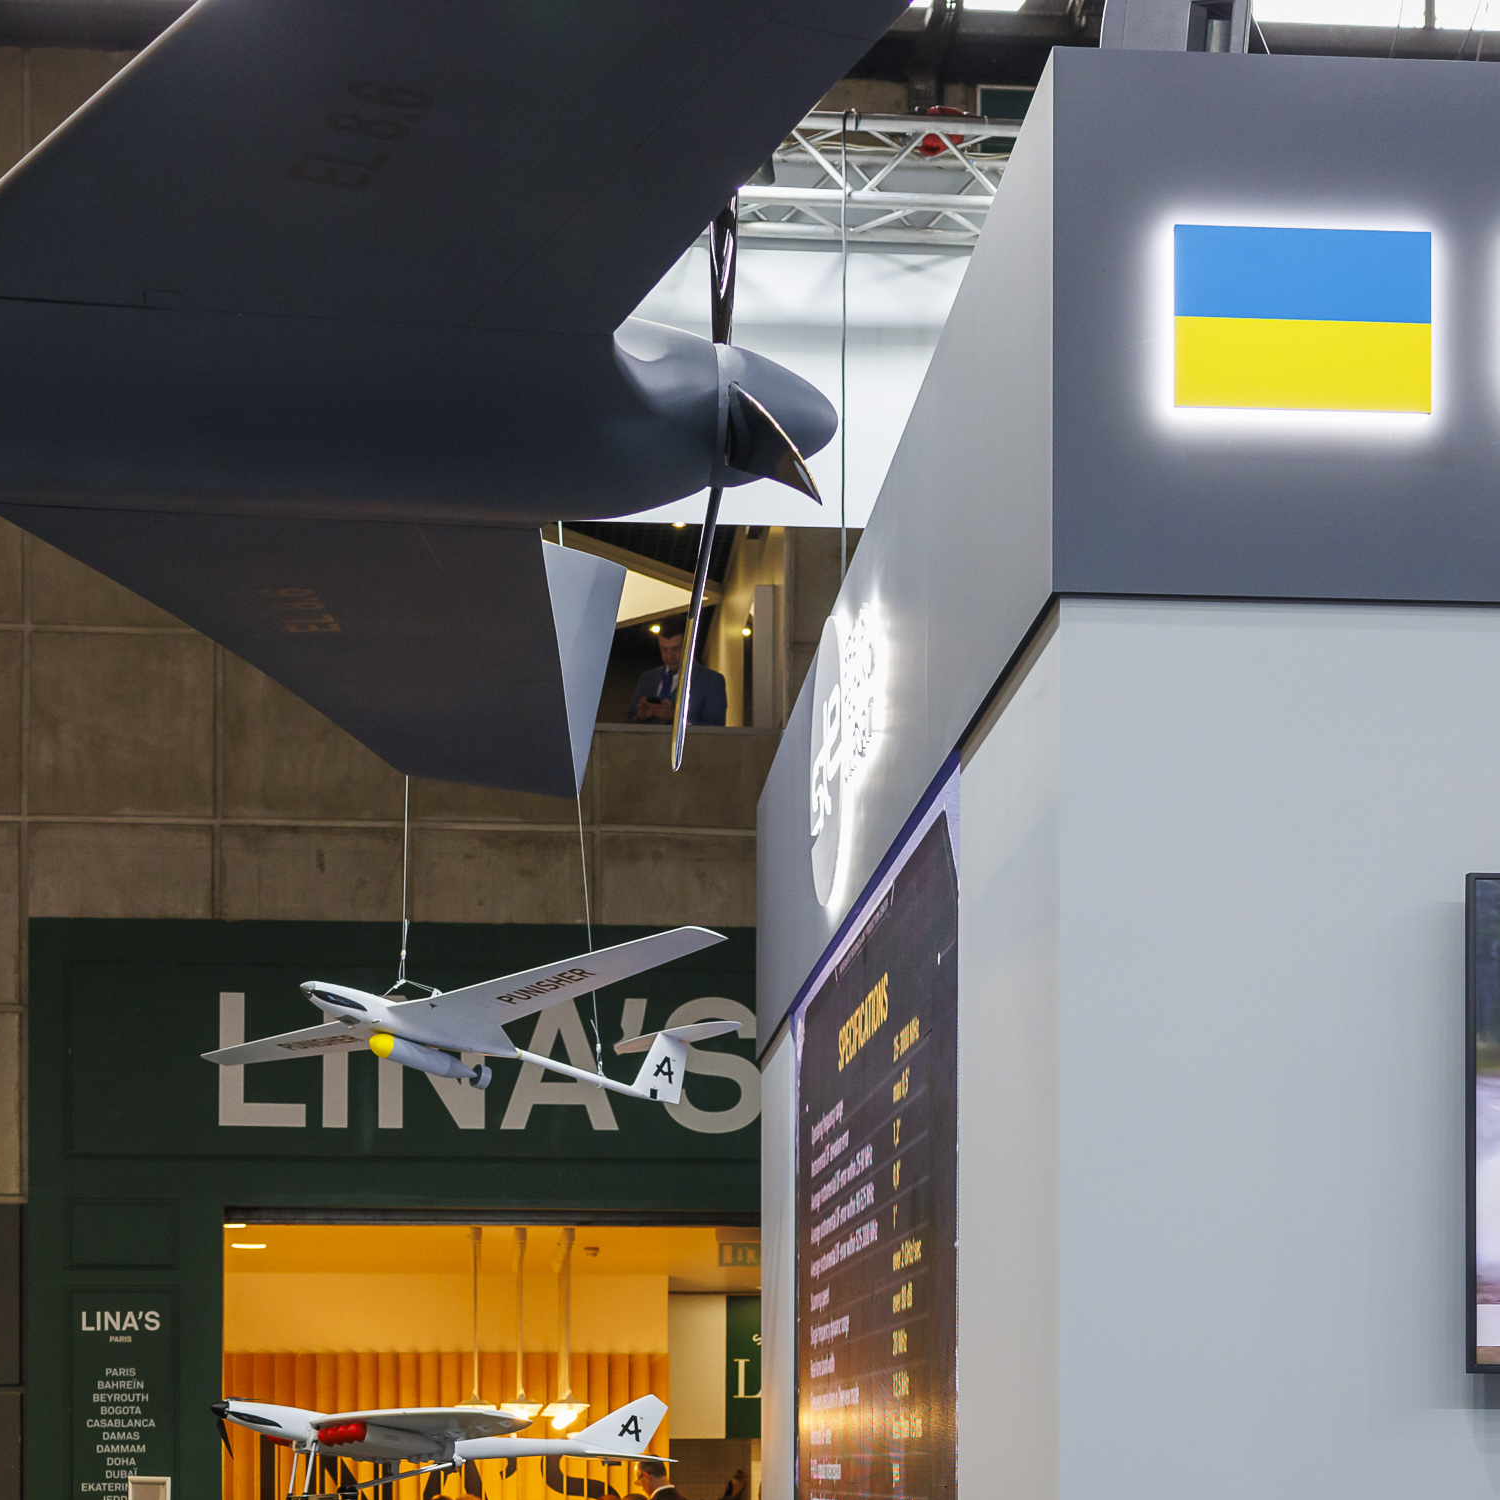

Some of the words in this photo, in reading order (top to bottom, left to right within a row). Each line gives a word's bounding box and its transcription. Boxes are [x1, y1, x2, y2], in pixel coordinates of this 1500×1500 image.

[496, 968, 597, 1005] PUNISHER
[838, 972, 889, 1073] SPECIFICATIONS
[81, 1310, 161, 1332] LINA'S
[105, 1368, 136, 1377] PARIS
[97, 1378, 145, 1390] BAHREÏN
[92, 1393, 149, 1403] BEYROUTH
[100, 1406, 142, 1415] BOGOTA
[86, 1418, 156, 1428] CASABLANCA
[102, 1431, 140, 1441] DAMAS
[96, 1444, 146, 1453] DAMMAM
[106, 1457, 137, 1466] DOHA
